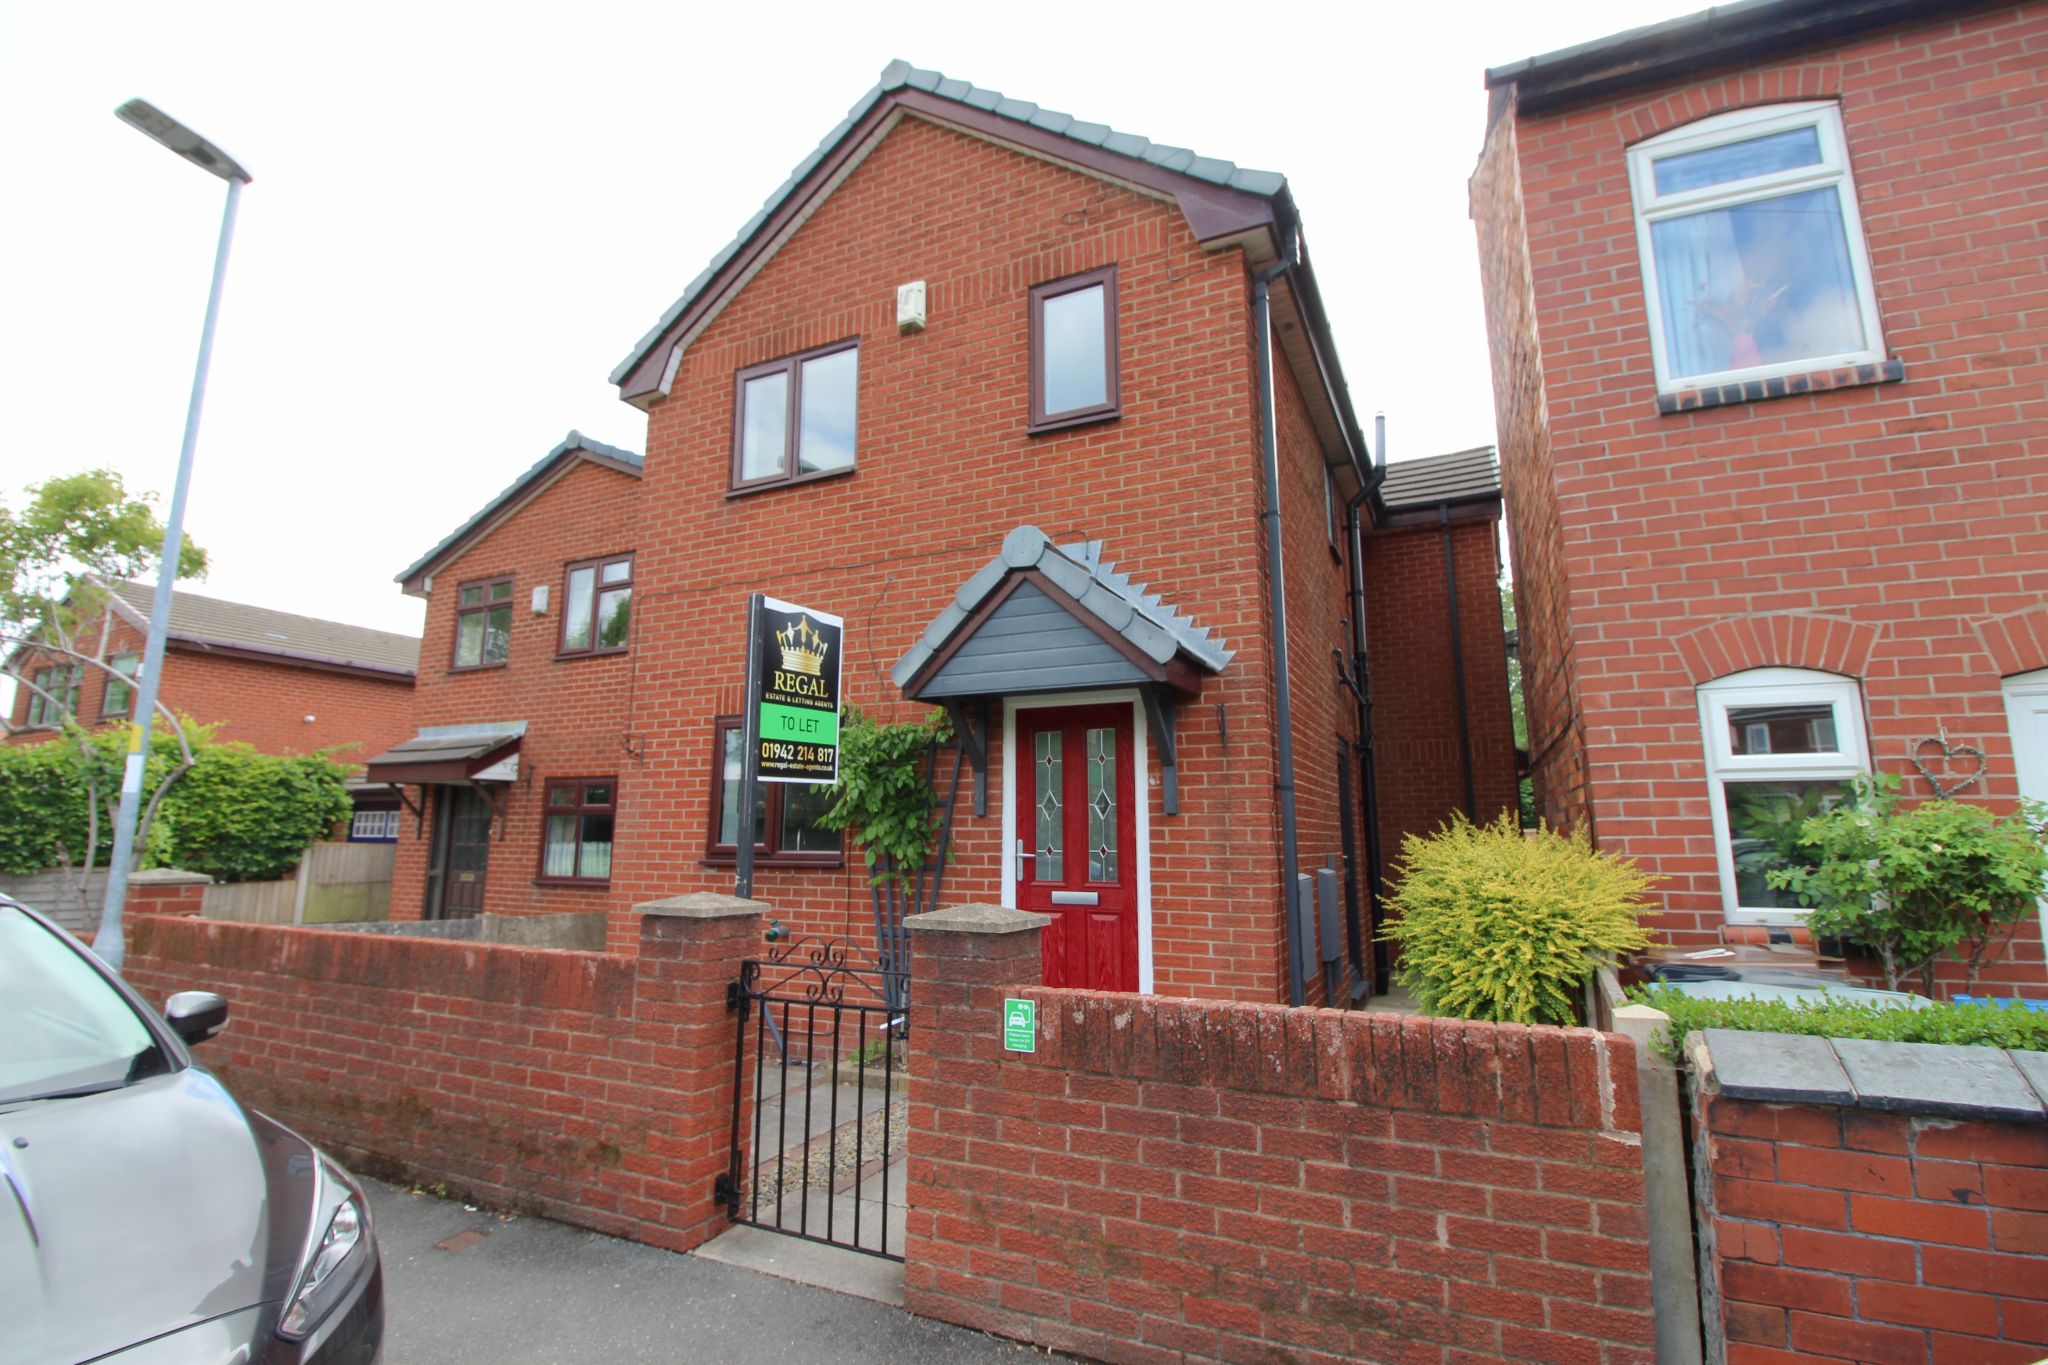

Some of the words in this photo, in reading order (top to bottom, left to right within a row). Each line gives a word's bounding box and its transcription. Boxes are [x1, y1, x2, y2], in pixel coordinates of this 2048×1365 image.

[774, 671, 828, 697] REGAL
[766, 692, 785, 702] ESTATE
[792, 697, 813, 706] LETTING
[815, 700, 833, 708] AGENTS
[781, 715, 795, 730] TO
[799, 718, 819, 733] LET
[762, 742, 794, 759] 01942
[797, 746, 814, 761] 214
[817, 748, 834, 763] 817
